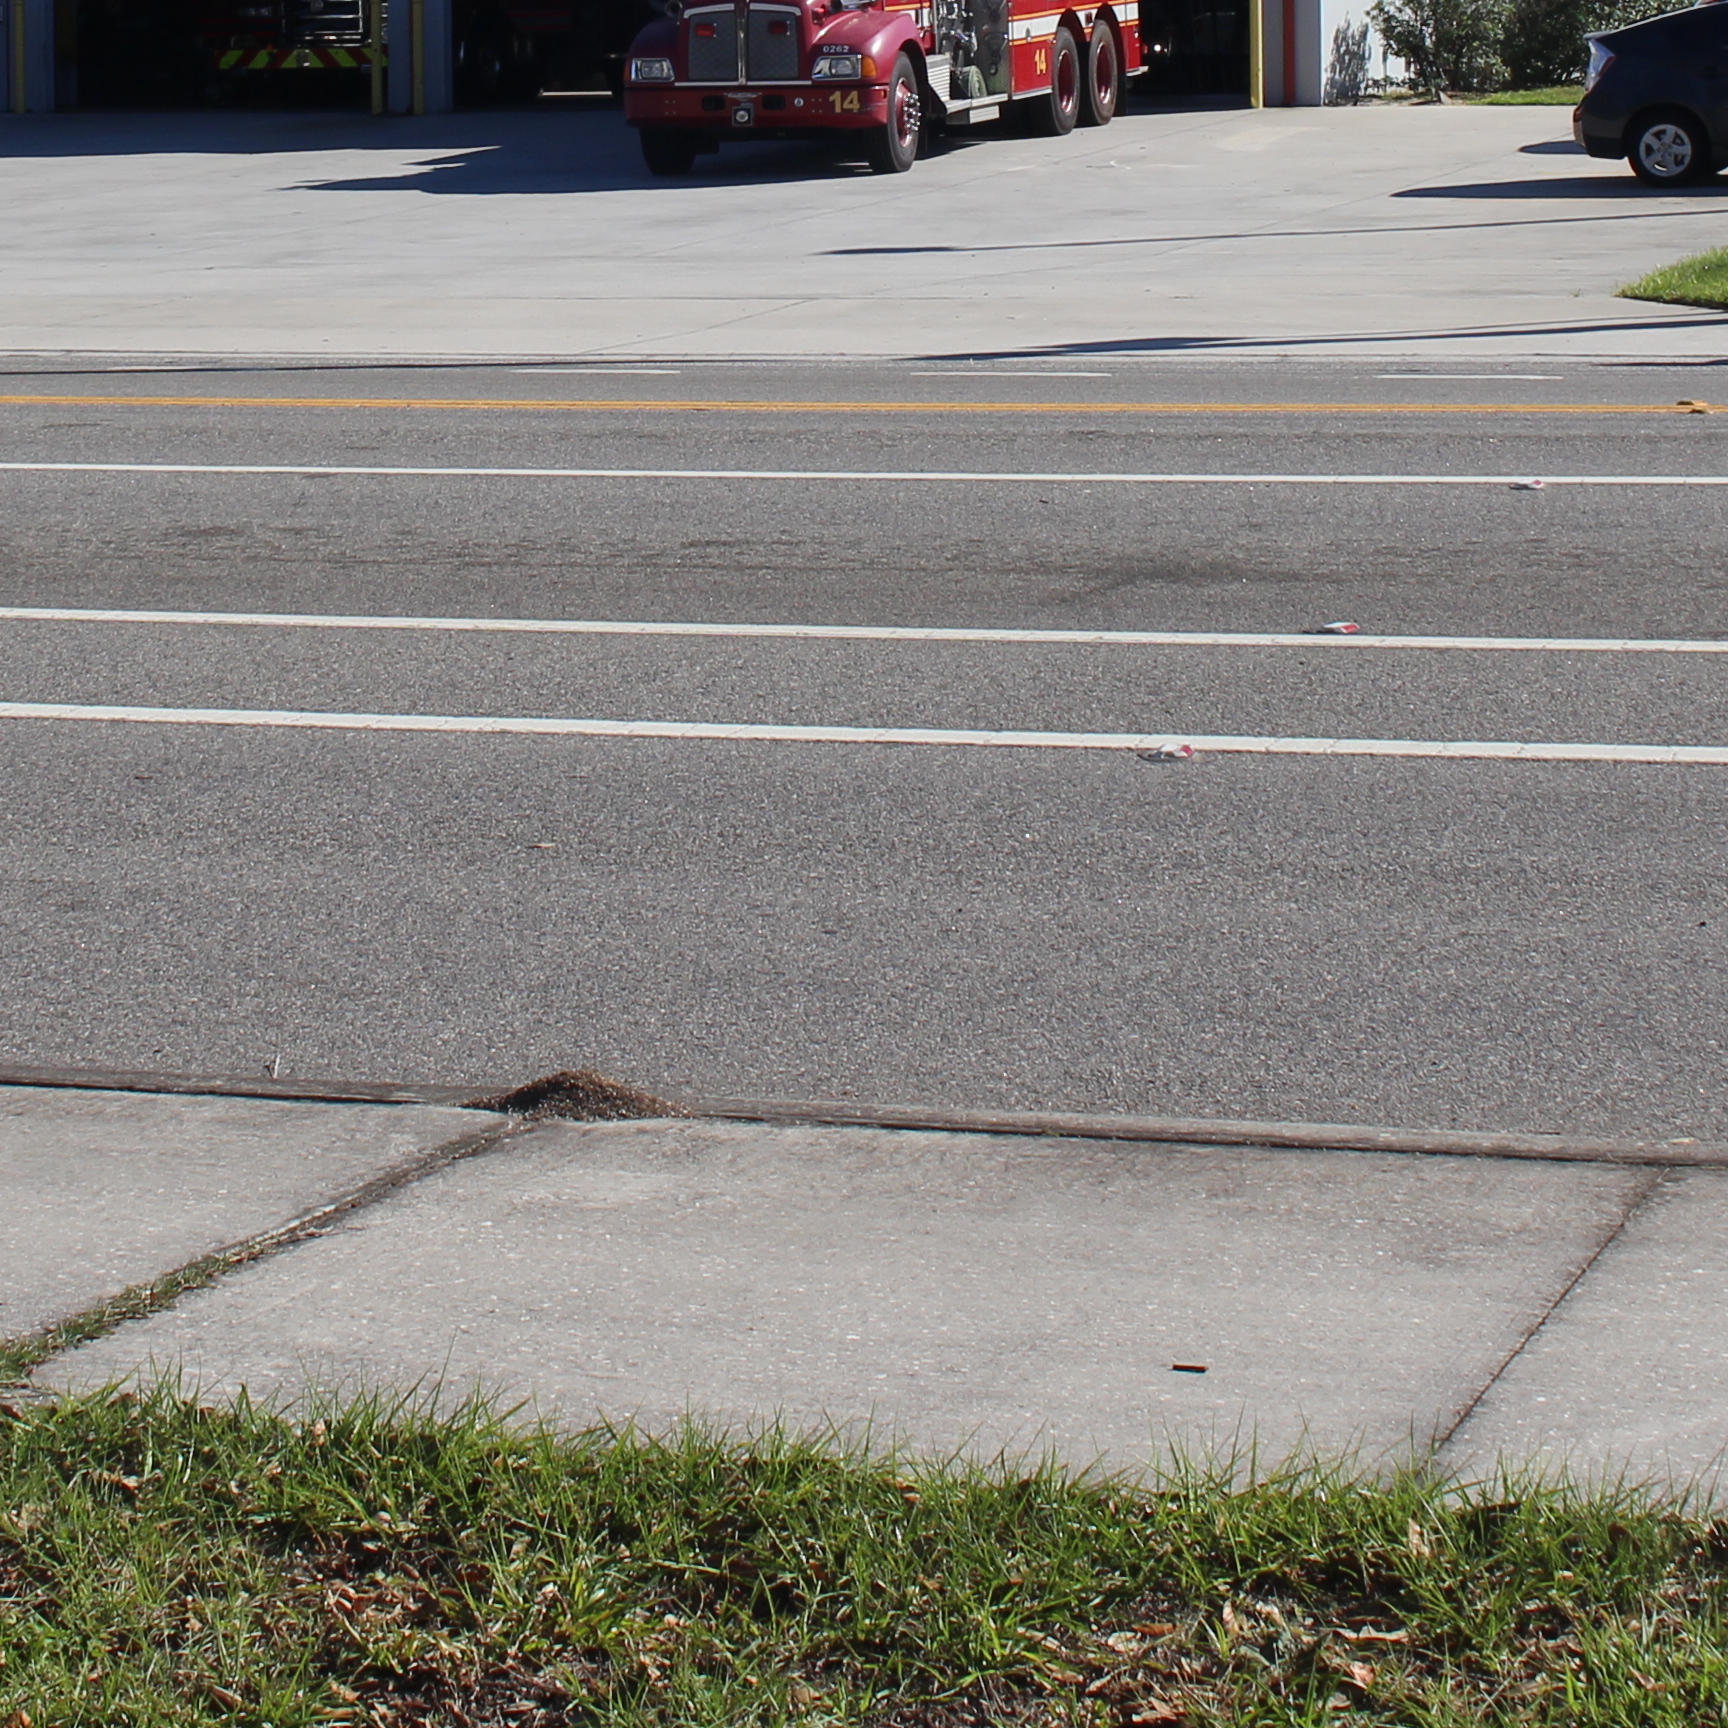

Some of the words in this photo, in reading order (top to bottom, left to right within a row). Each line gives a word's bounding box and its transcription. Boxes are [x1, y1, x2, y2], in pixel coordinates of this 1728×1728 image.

[823, 45, 850, 53] 0262
[1034, 48, 1047, 76] 14
[828, 90, 861, 113] 14
